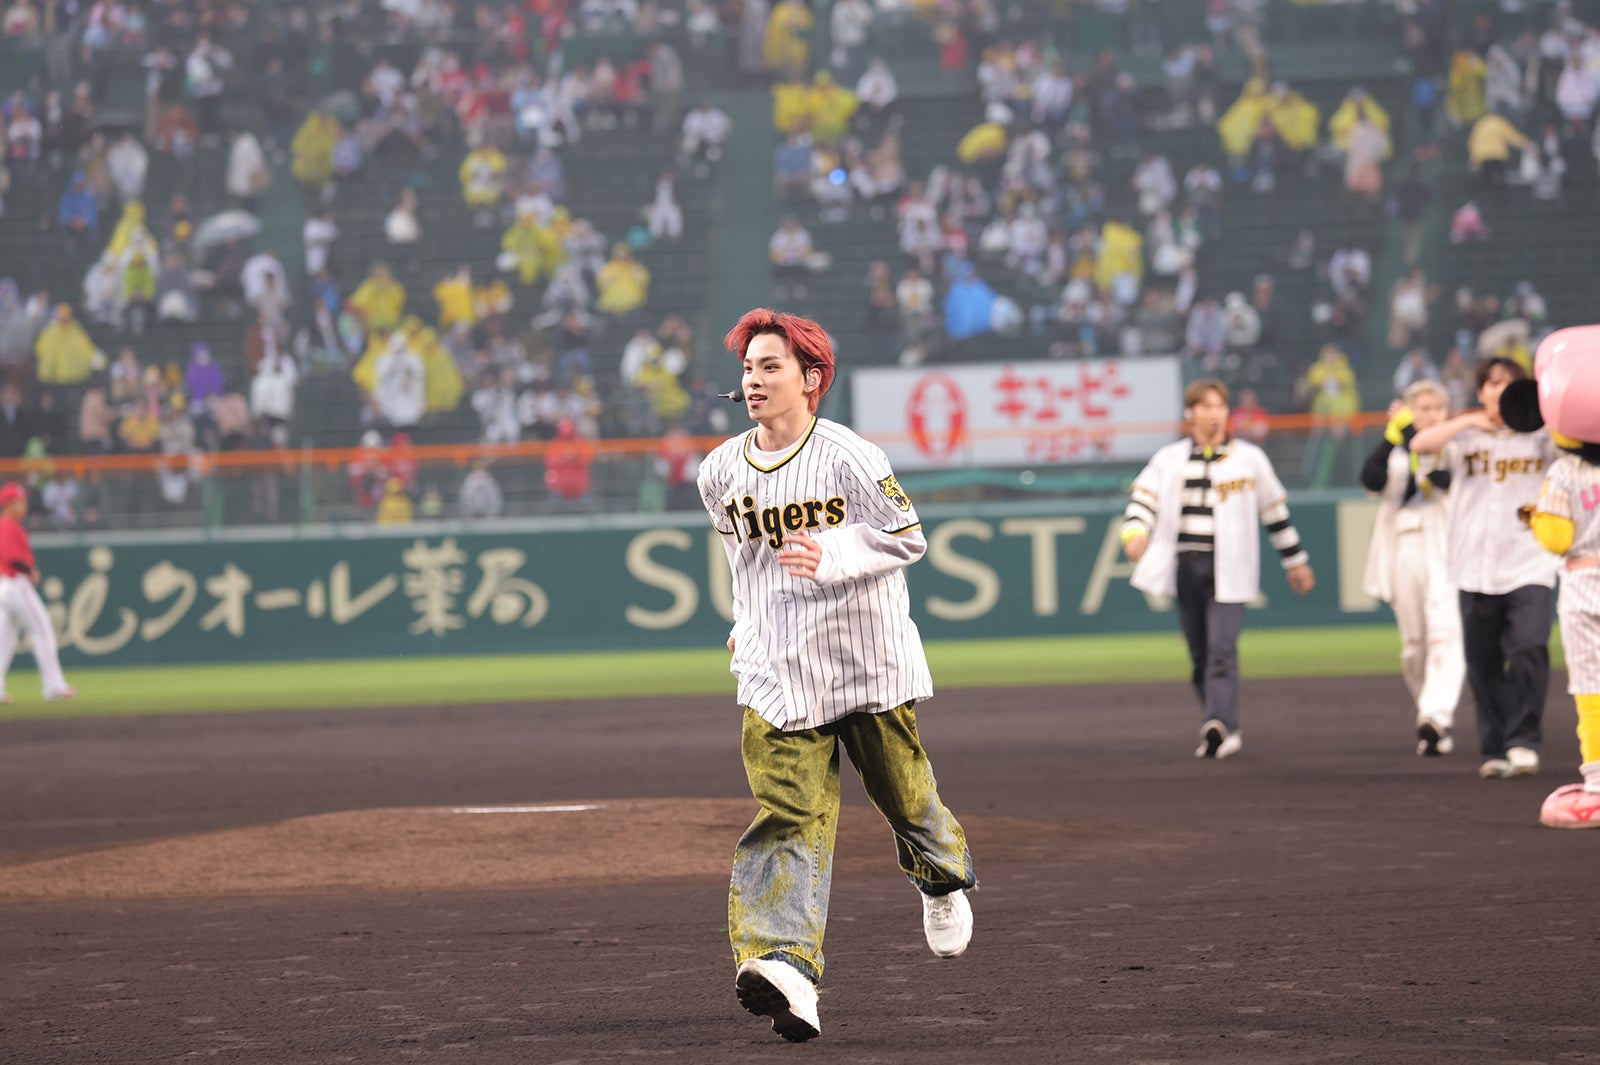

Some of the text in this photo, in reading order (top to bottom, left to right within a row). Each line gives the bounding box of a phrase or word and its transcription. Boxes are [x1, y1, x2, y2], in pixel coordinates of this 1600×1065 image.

[992, 360, 1134, 427] キューピー
[724, 495, 846, 550] Tigers
[141, 537, 548, 642] クオール薬局
